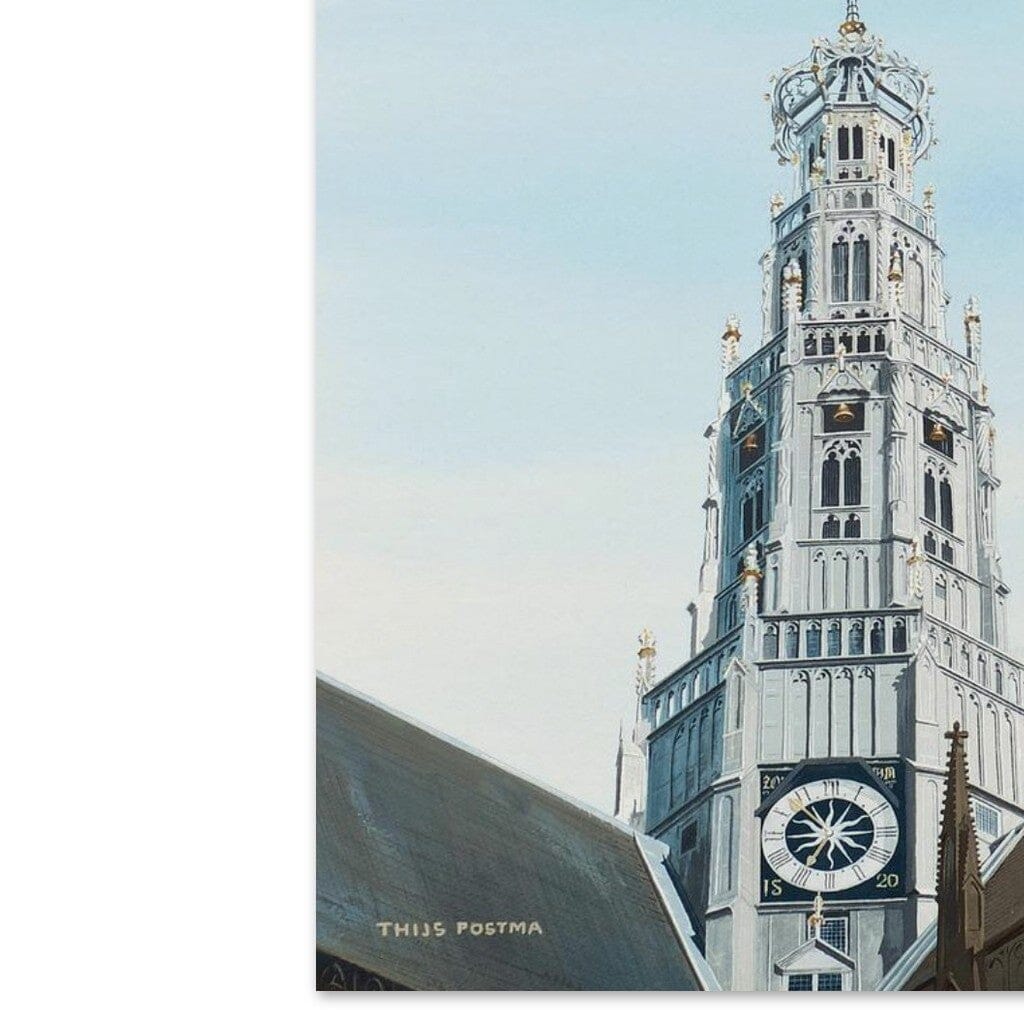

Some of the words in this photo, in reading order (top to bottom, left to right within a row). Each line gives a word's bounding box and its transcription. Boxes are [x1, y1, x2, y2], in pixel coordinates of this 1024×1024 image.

[875, 873, 900, 888] 20
[375, 921, 446, 938] THIJS
[456, 920, 544, 937] POSTMA
